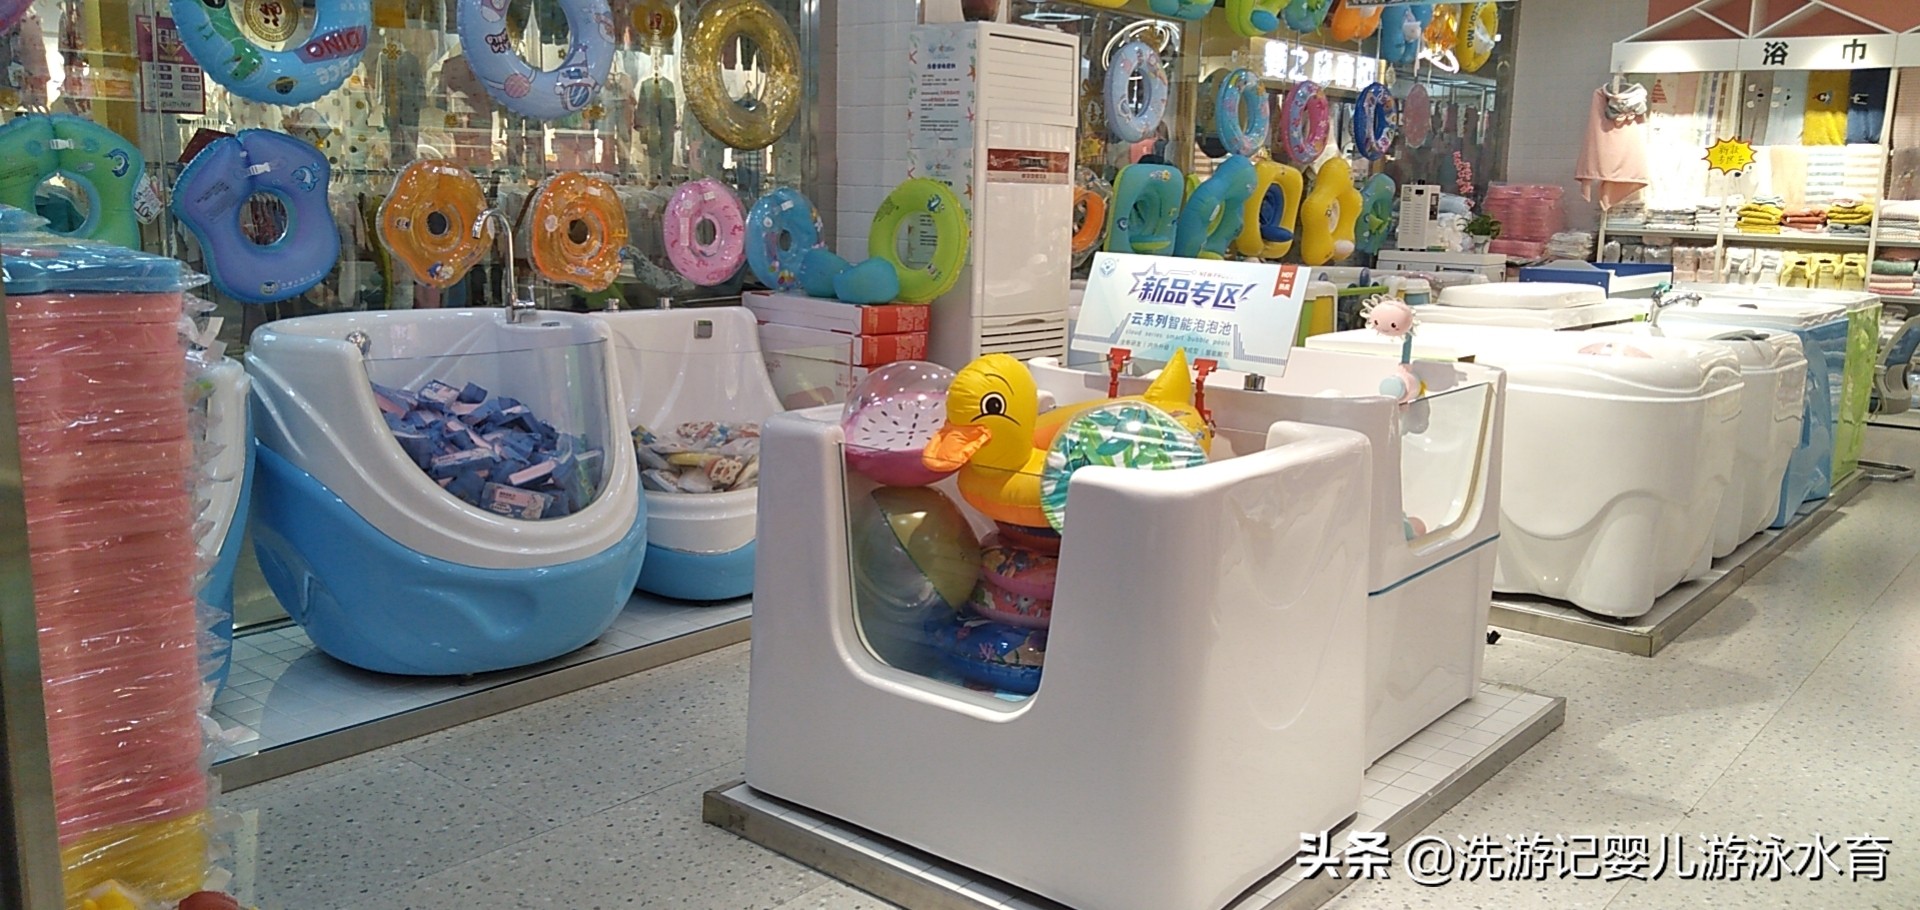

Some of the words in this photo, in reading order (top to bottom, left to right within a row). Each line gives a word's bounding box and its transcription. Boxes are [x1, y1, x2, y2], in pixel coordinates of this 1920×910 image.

[1762, 38, 1868, 66] 浴巾
[1138, 275, 1243, 310] 新品专区
[1125, 328, 1142, 336] cloud
[1166, 333, 1184, 341] smart
[1187, 335, 1209, 343] bubble
[1212, 338, 1231, 346] pools
[1131, 312, 1232, 336] 云系列智能泡泡池
